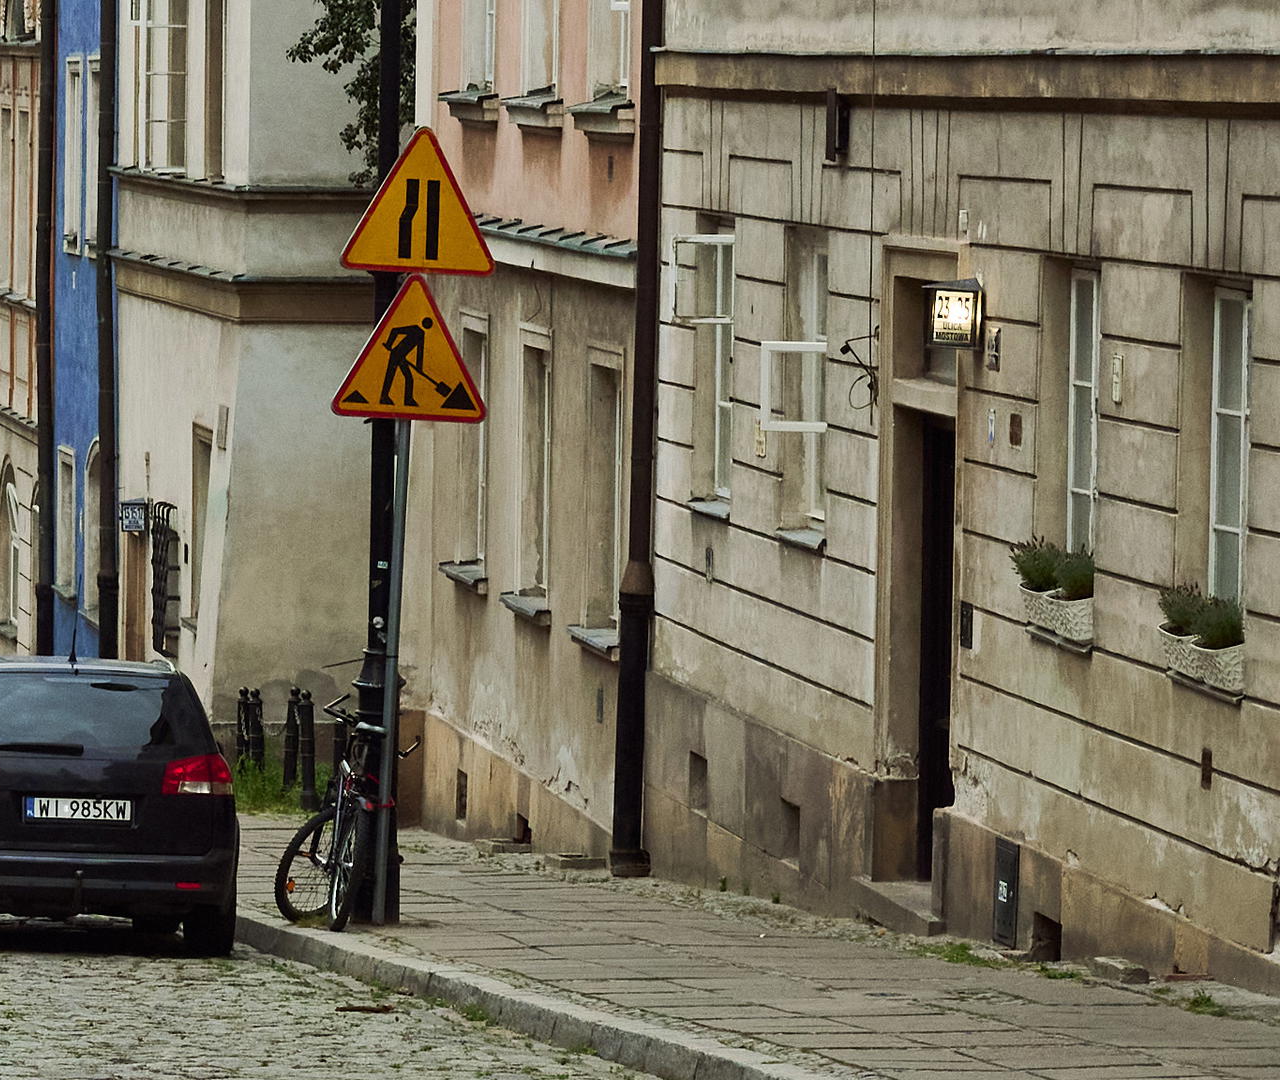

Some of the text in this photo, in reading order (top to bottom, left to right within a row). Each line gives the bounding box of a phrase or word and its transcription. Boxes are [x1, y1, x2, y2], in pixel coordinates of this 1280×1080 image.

[937, 296, 949, 319] 23
[39, 799, 59, 817] WI
[69, 800, 127, 819] 985KW
